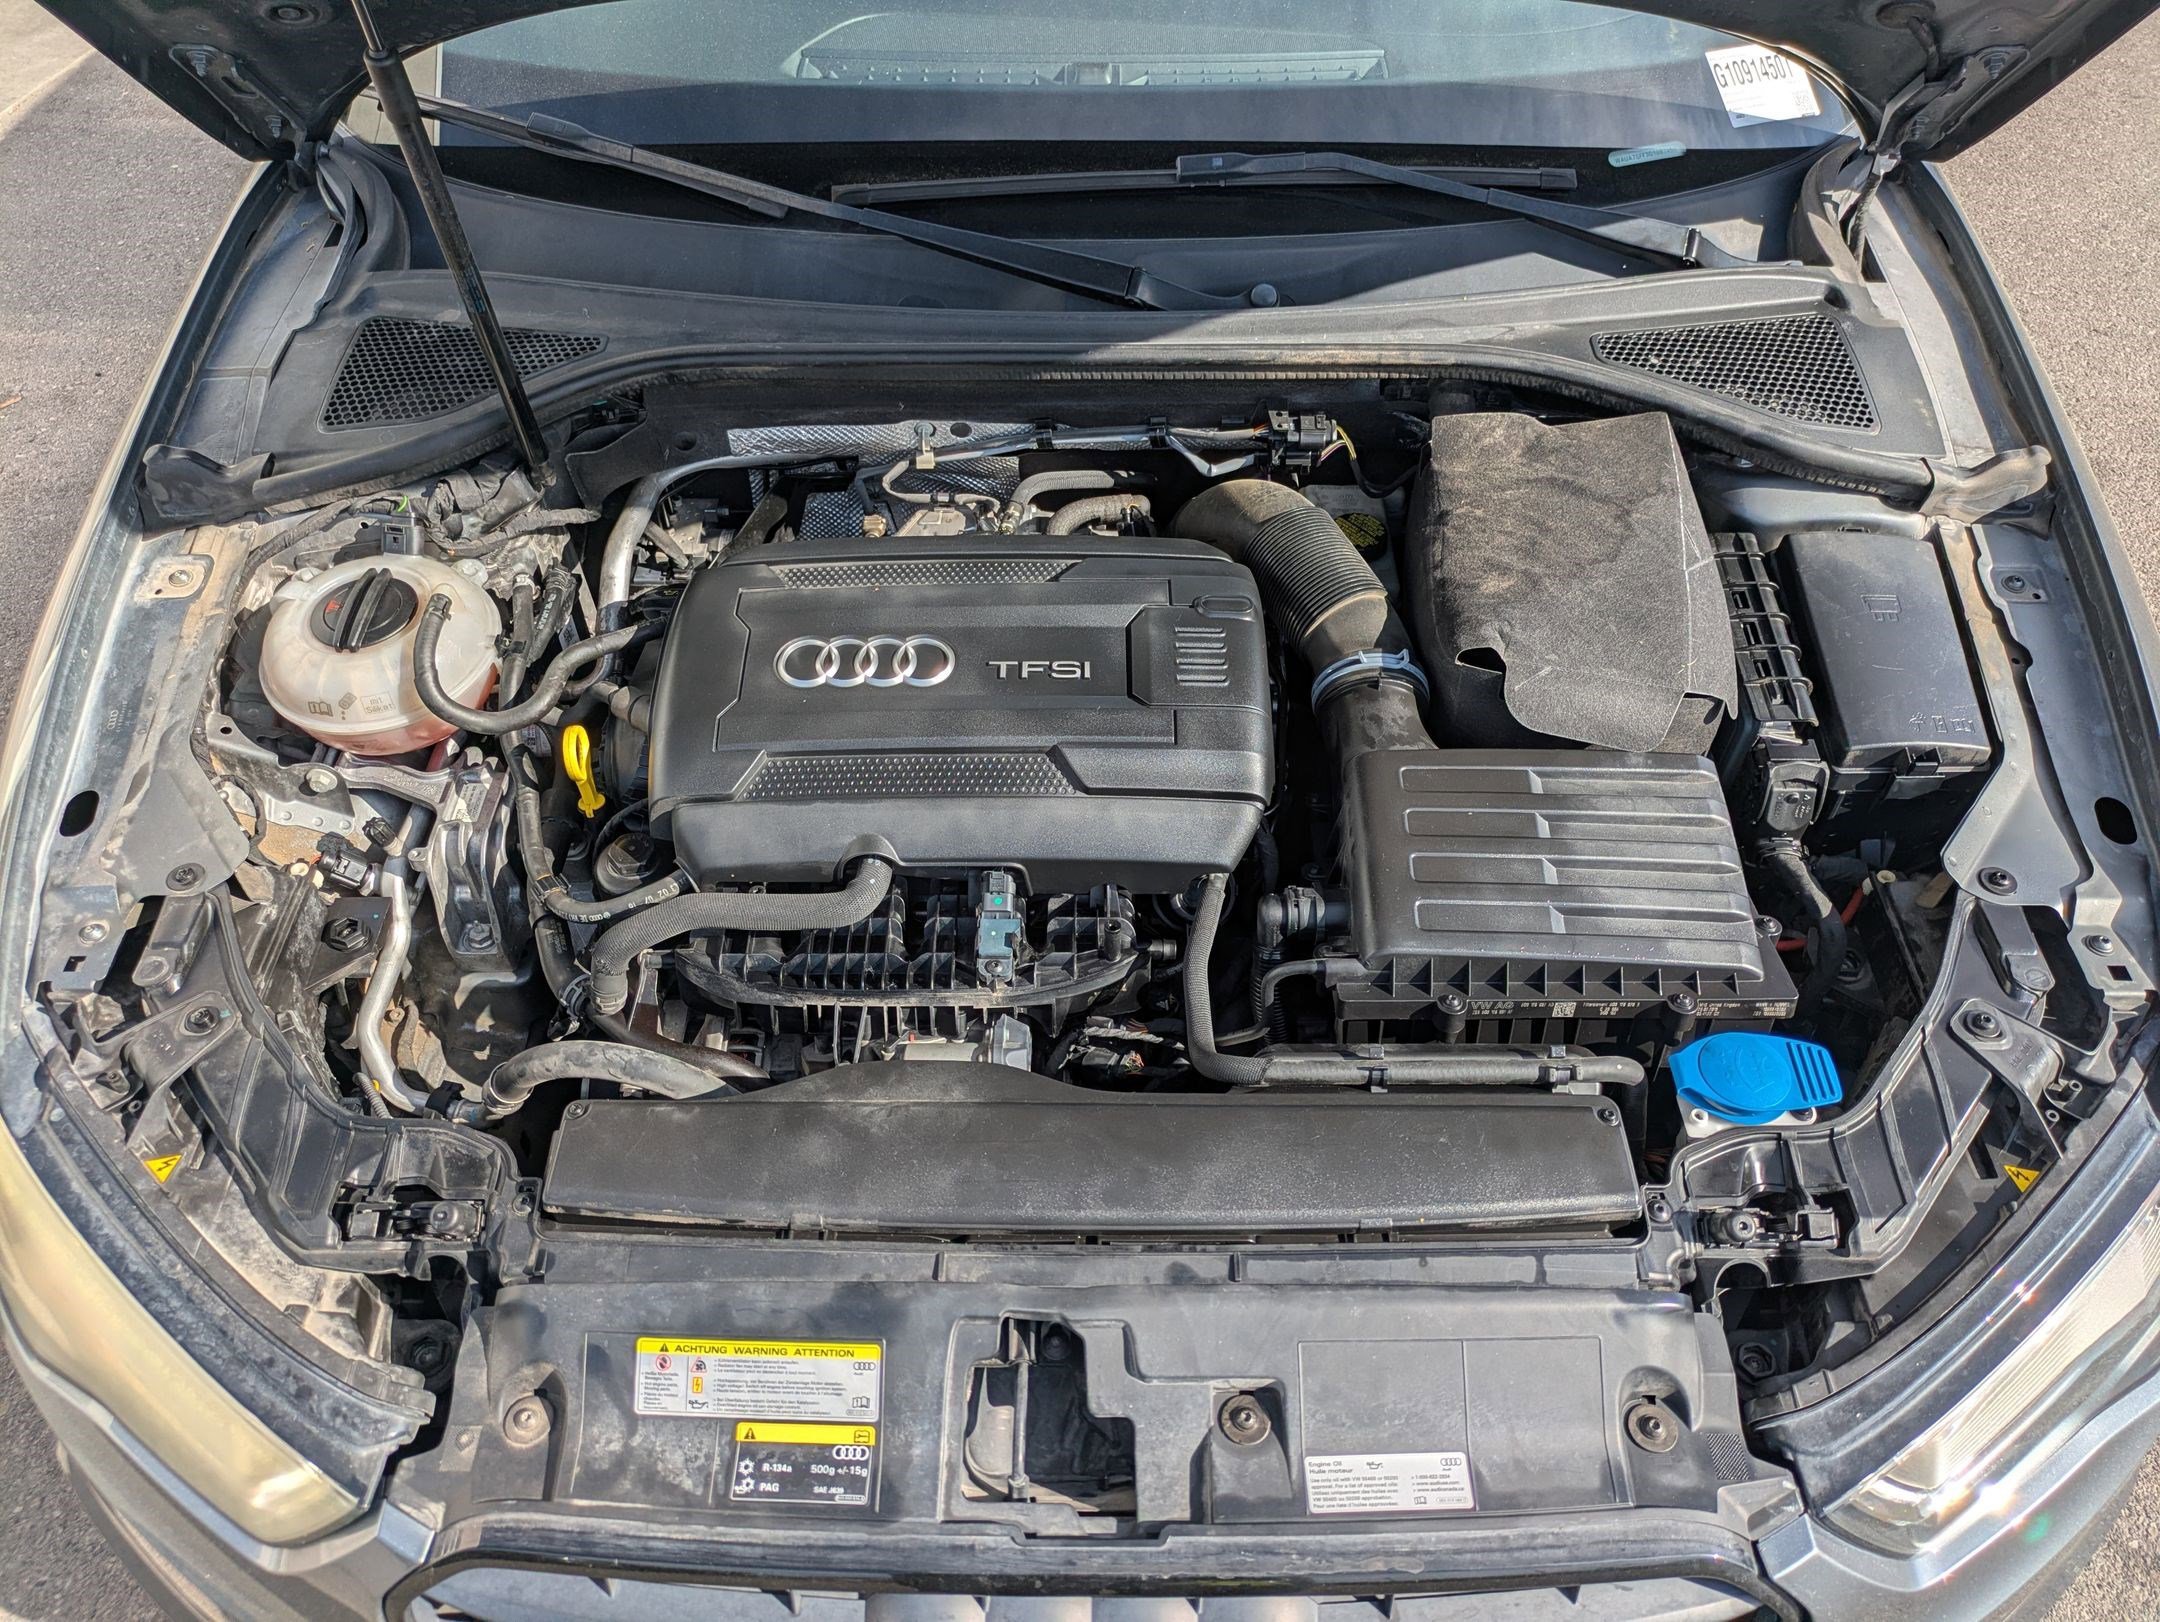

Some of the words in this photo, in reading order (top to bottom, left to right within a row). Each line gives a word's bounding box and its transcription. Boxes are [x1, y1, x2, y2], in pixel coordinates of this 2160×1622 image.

[987, 661, 1091, 679] TFSI
[1471, 1001, 1493, 1010] VW
[1494, 1001, 1515, 1010] AG
[674, 1344, 728, 1354] ACHTUNG
[733, 1345, 788, 1356] WARNING
[793, 1347, 855, 1358] ATTENTION
[762, 1462, 793, 1473] R-134a
[810, 1464, 835, 1477] 500g
[759, 1483, 780, 1492] PAG
[813, 1486, 828, 1494] SAE
